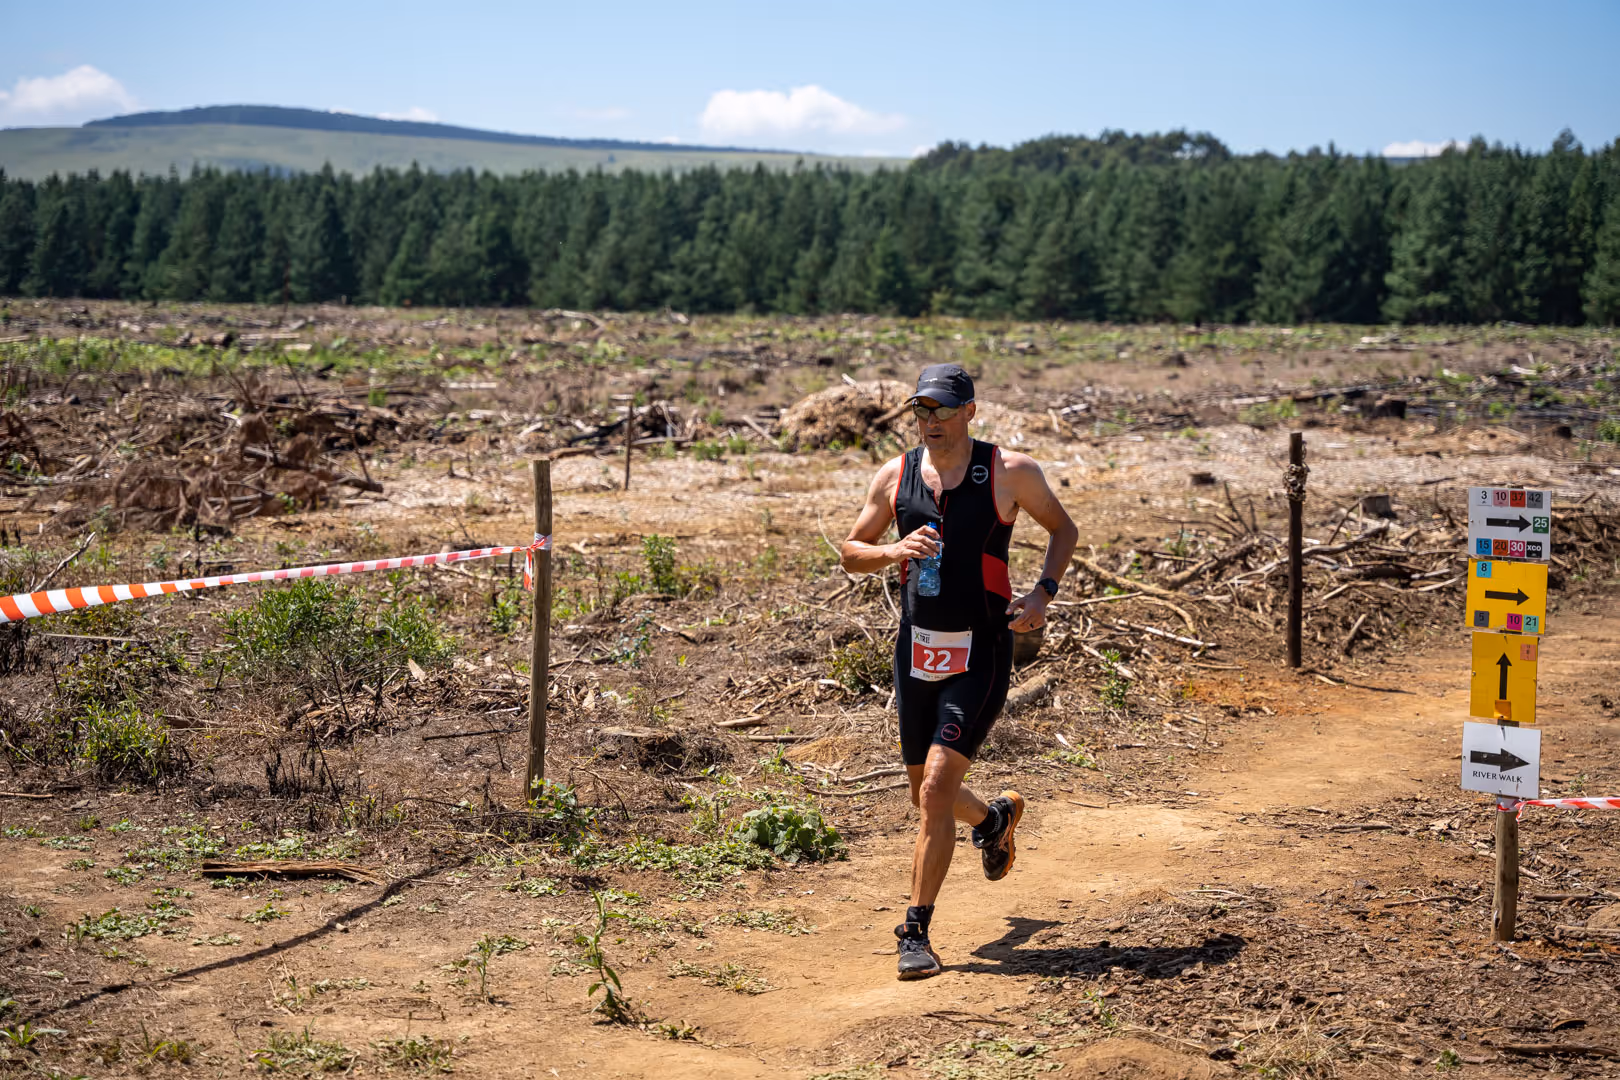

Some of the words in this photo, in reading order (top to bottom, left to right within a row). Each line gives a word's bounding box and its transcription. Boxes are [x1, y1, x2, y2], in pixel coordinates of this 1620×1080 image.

[1481, 490, 1488, 500] 3
[1495, 491, 1507, 501] 10
[1511, 492, 1524, 501] 37
[1528, 493, 1541, 503] 42
[1534, 517, 1548, 528] 25
[1479, 540, 1490, 550] 15
[1494, 541, 1507, 551] 20
[1510, 541, 1524, 552] 30
[1481, 562, 1488, 573] 8
[1509, 615, 1520, 625] 10
[1525, 616, 1537, 627] 21
[923, 649, 952, 671] 22
[1472, 770, 1497, 780] RIVER
[1498, 773, 1523, 784] WALK
